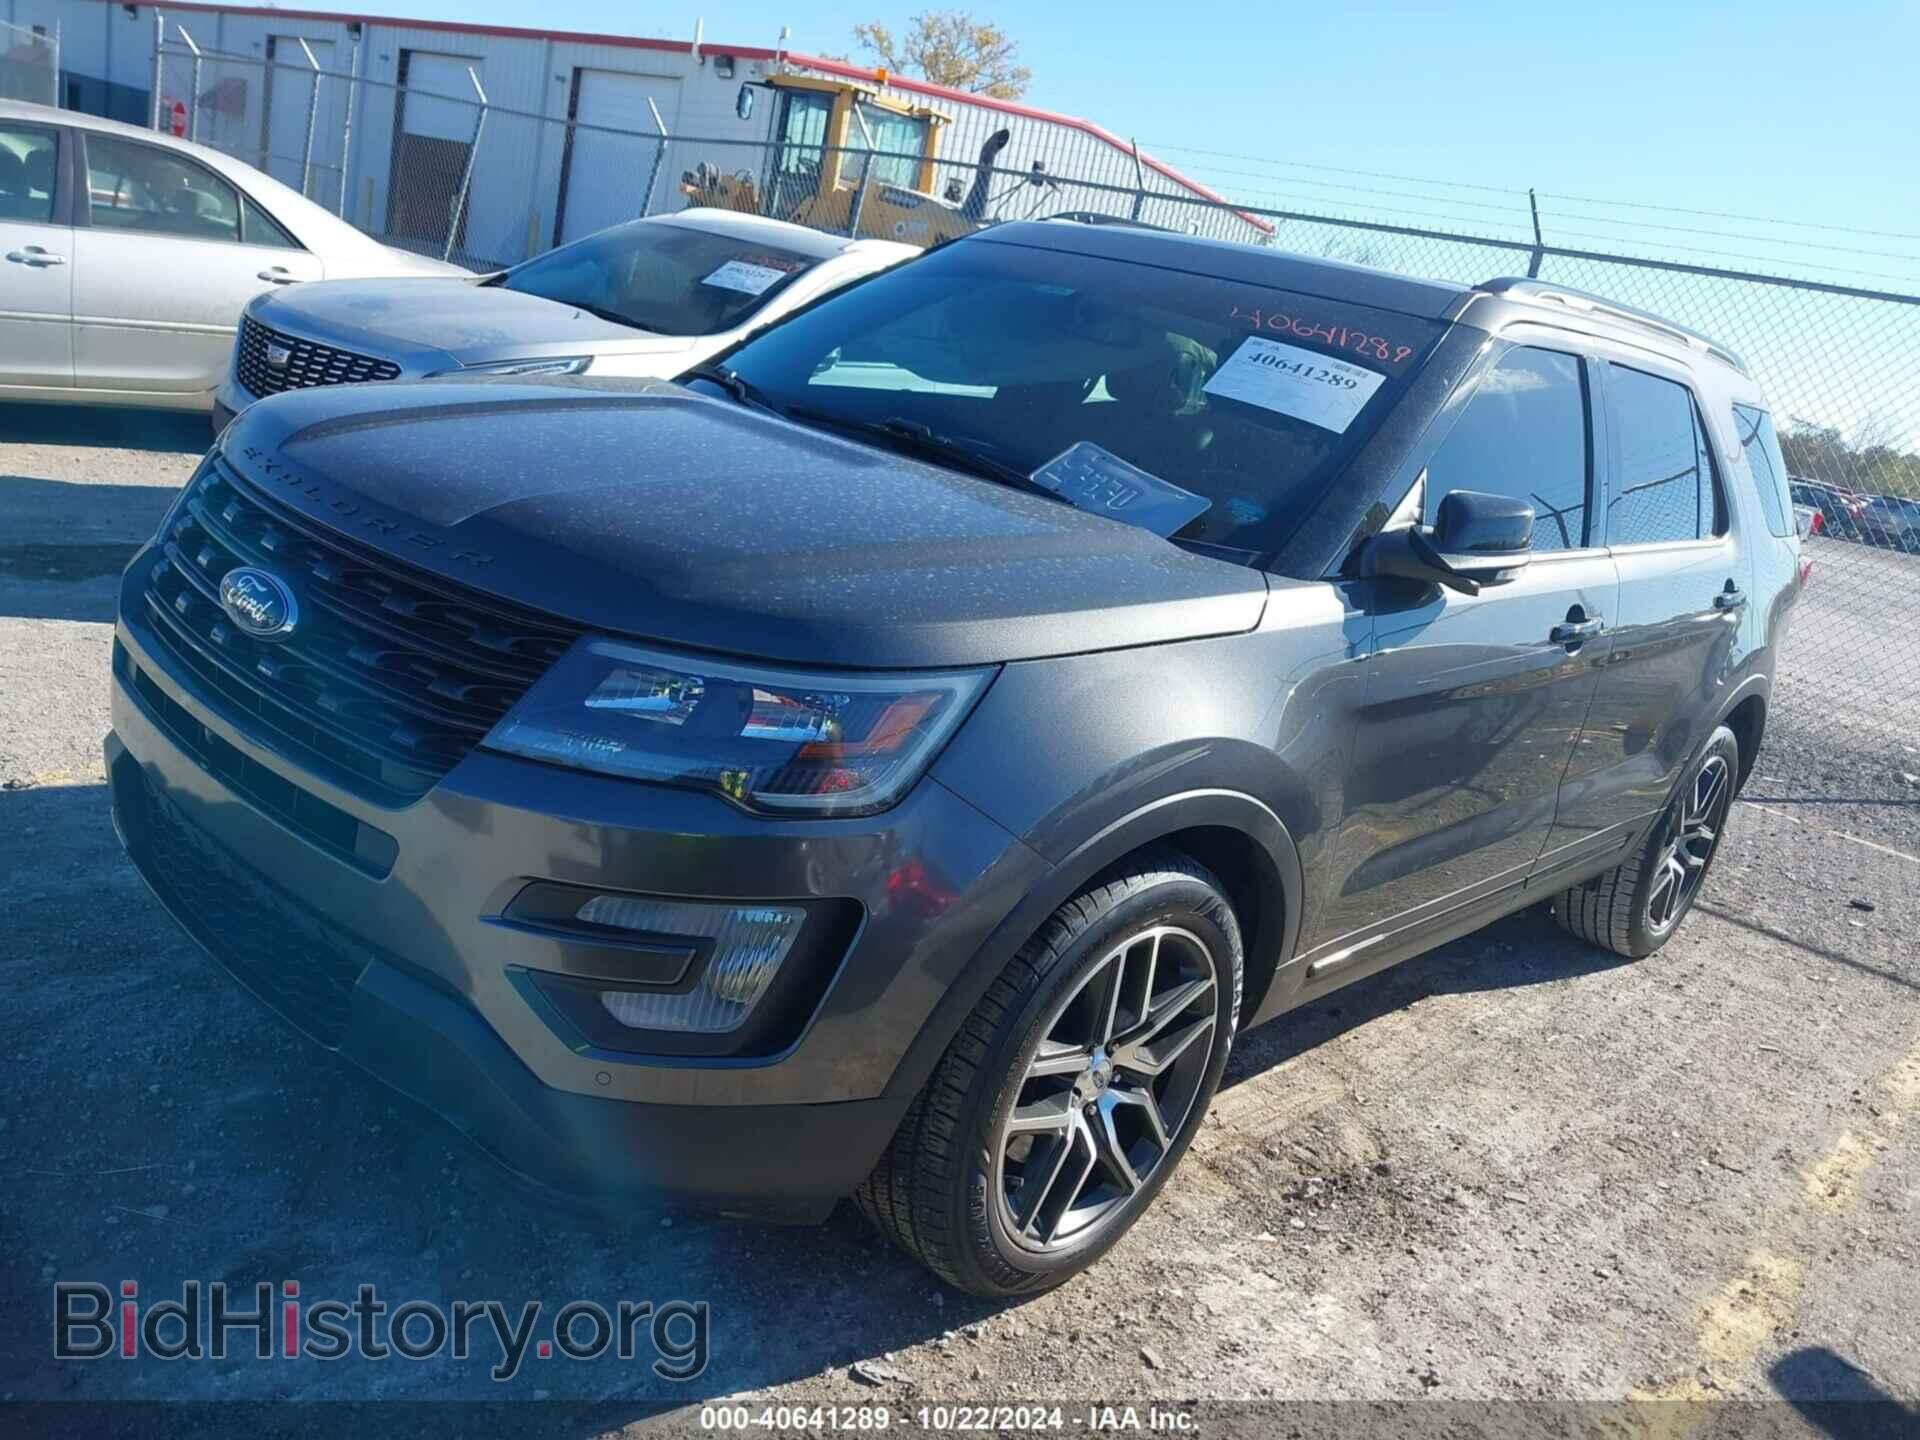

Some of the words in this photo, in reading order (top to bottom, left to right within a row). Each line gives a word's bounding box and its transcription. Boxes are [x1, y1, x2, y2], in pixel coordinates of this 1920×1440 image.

[1230, 306, 1412, 363] 40641289
[1248, 352, 1358, 391] 40641289
[226, 575, 275, 622] Ford
